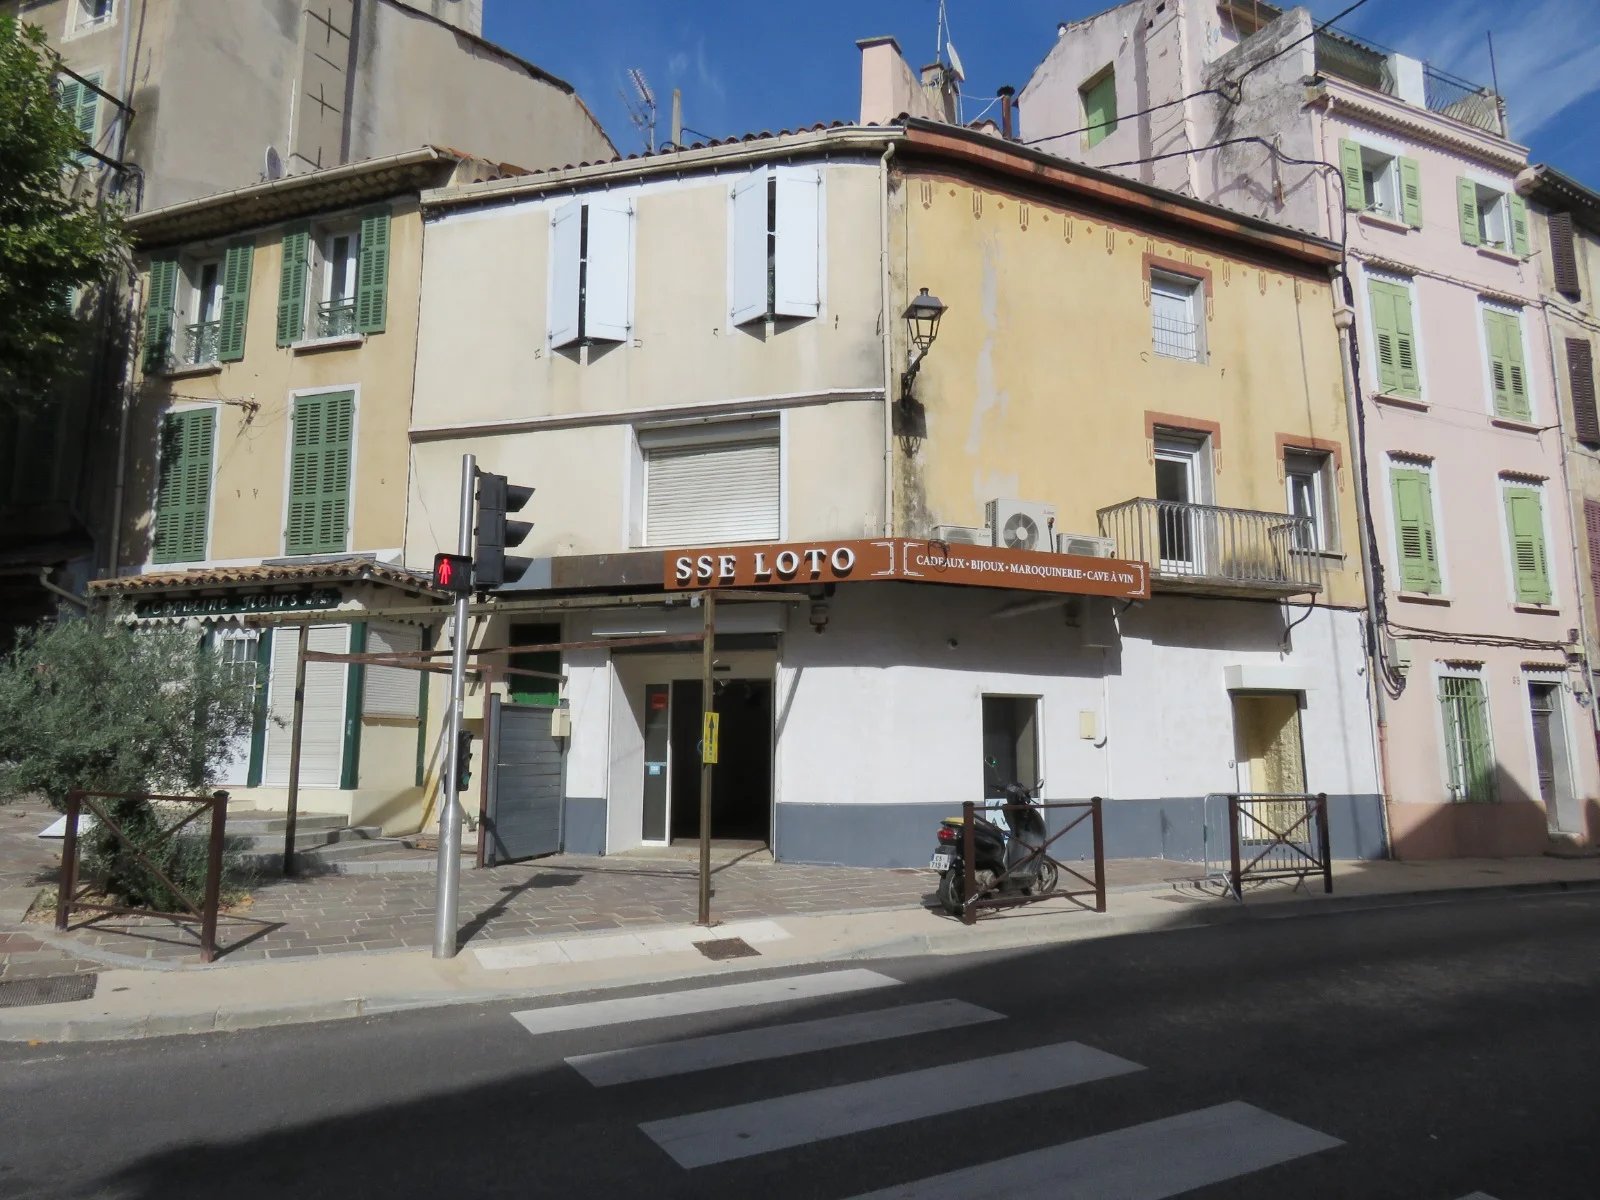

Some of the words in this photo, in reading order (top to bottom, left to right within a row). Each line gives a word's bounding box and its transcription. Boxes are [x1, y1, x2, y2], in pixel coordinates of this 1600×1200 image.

[676, 554, 737, 579] SSE
[753, 547, 855, 576] LOTO
[916, 554, 965, 569] CADEAUX
[971, 559, 1005, 572] BIJOUX
[1010, 563, 1082, 579] MAROQUINERIE
[1087, 570, 1109, 582] CAVE
[1110, 570, 1117, 582] À
[1118, 573, 1134, 584] VIN
